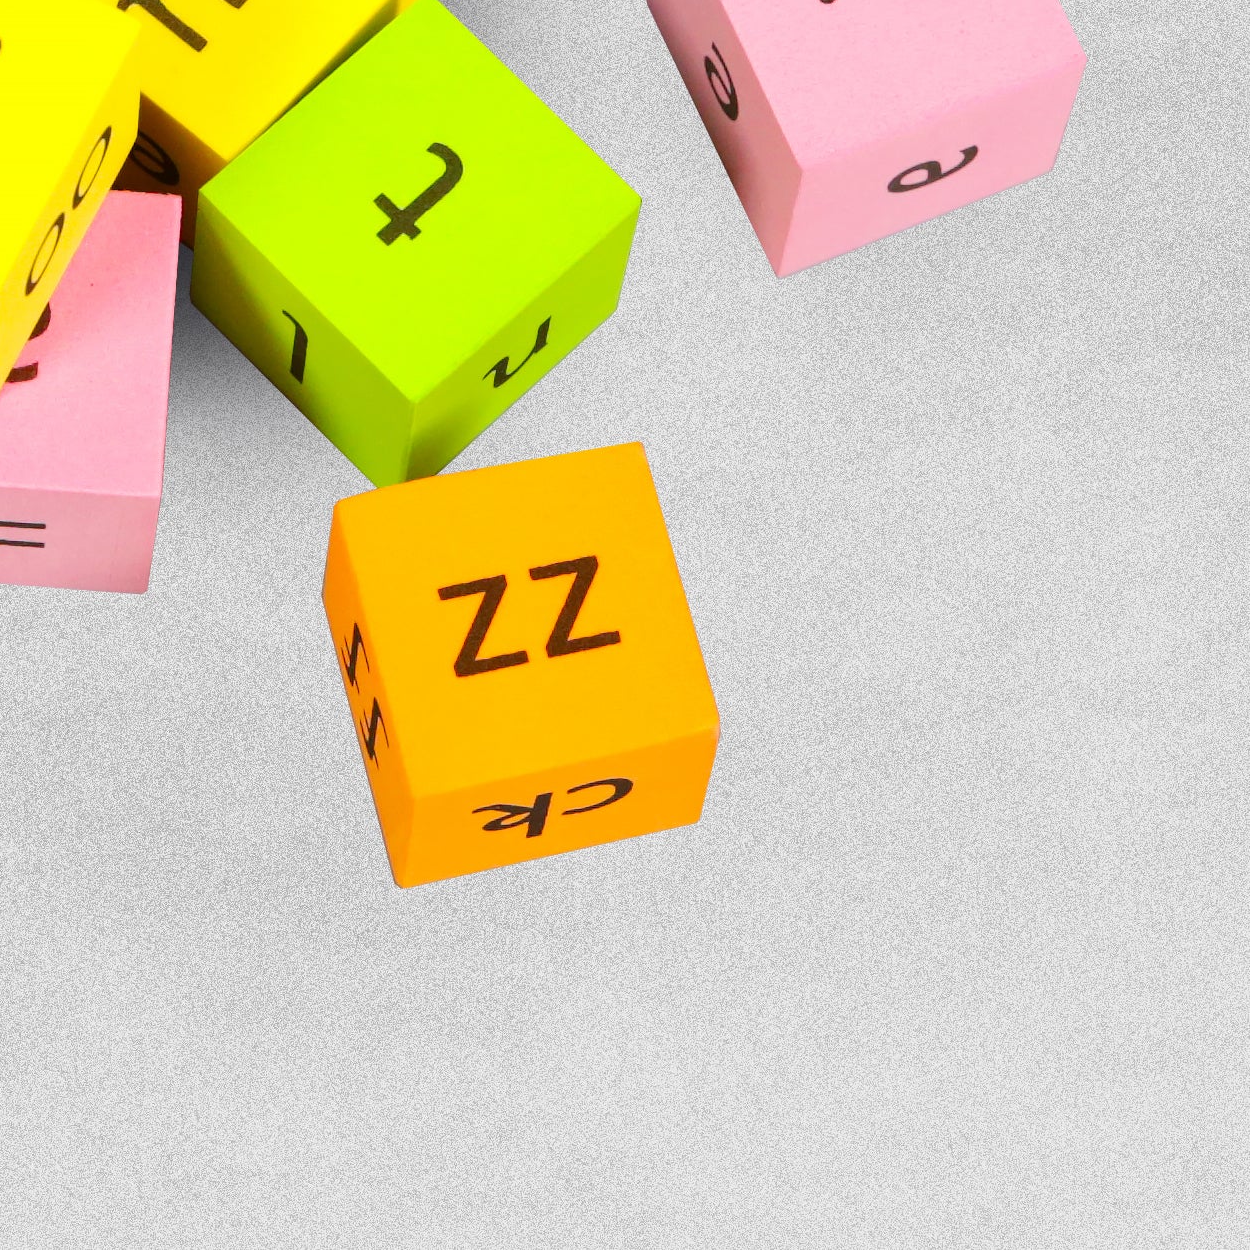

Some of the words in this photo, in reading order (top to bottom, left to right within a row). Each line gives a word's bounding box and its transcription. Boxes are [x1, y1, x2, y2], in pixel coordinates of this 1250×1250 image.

[23, 123, 113, 296] oo
[372, 141, 465, 247] t
[437, 554, 622, 679] zz
[471, 776, 635, 839] ck
